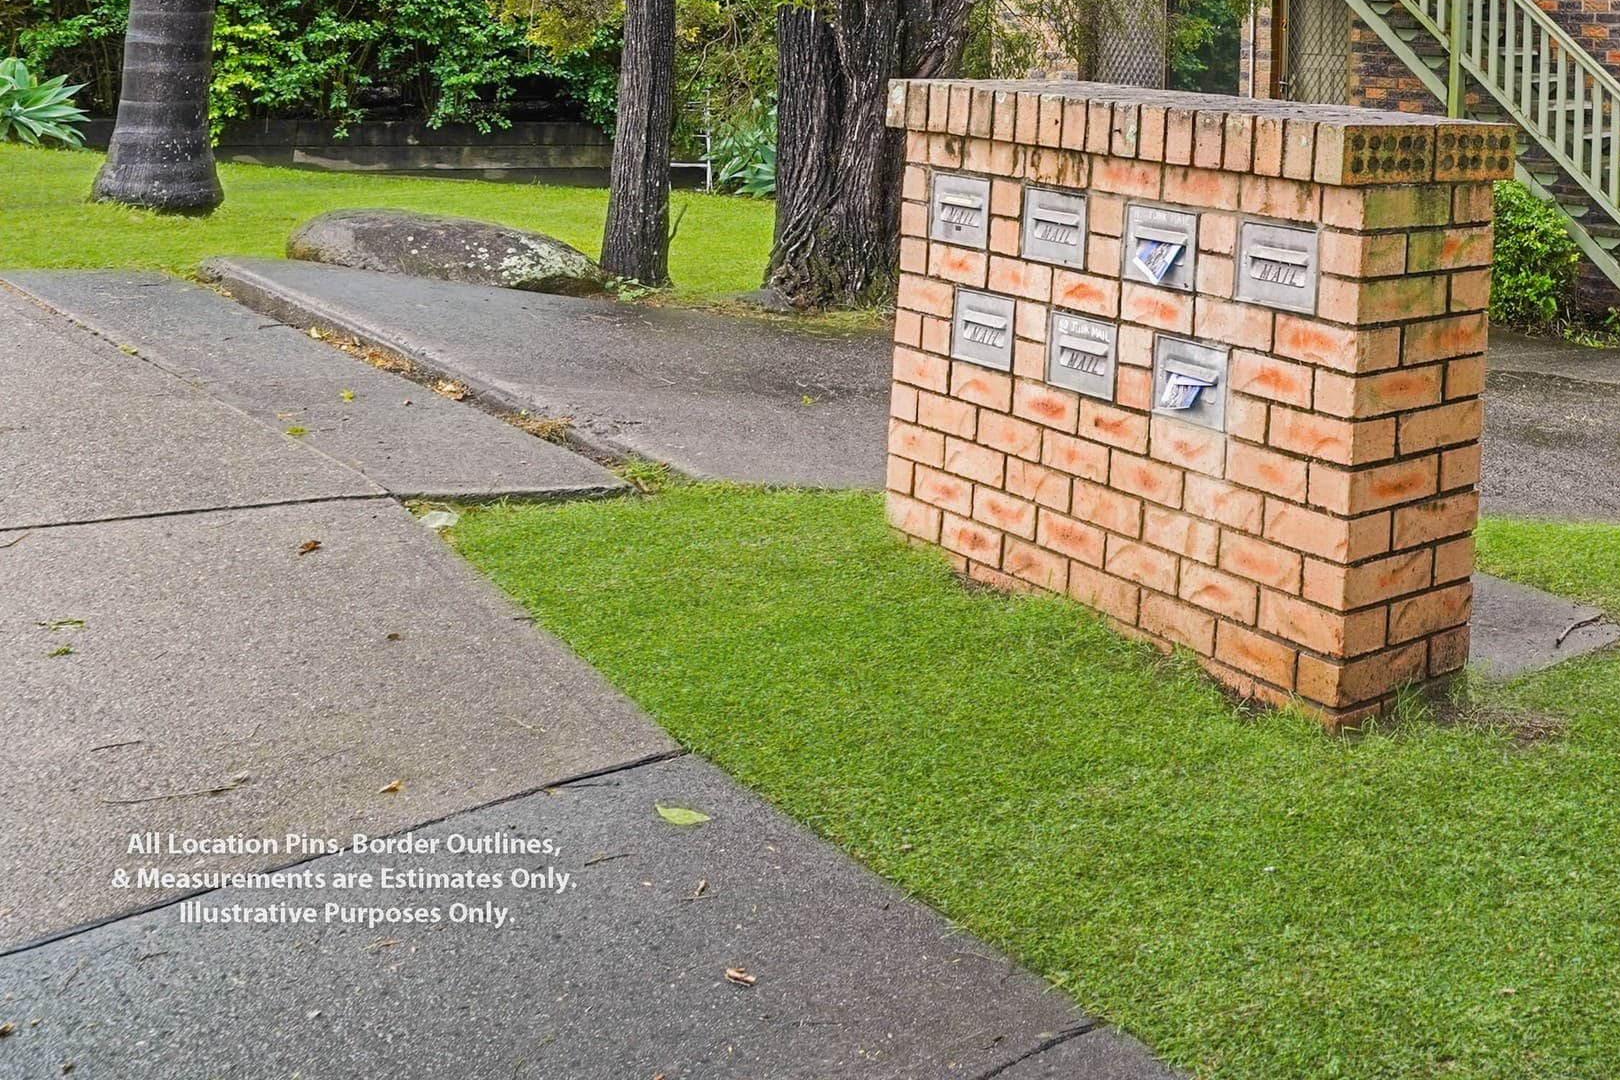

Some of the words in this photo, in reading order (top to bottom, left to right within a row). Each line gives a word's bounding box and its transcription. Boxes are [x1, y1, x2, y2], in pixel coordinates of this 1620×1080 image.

[947, 208, 978, 227] MAIL
[1042, 224, 1074, 244] MAIL
[1260, 263, 1297, 285] MAIL
[971, 325, 1002, 347] MAIL
[1068, 352, 1099, 374] MAIL
